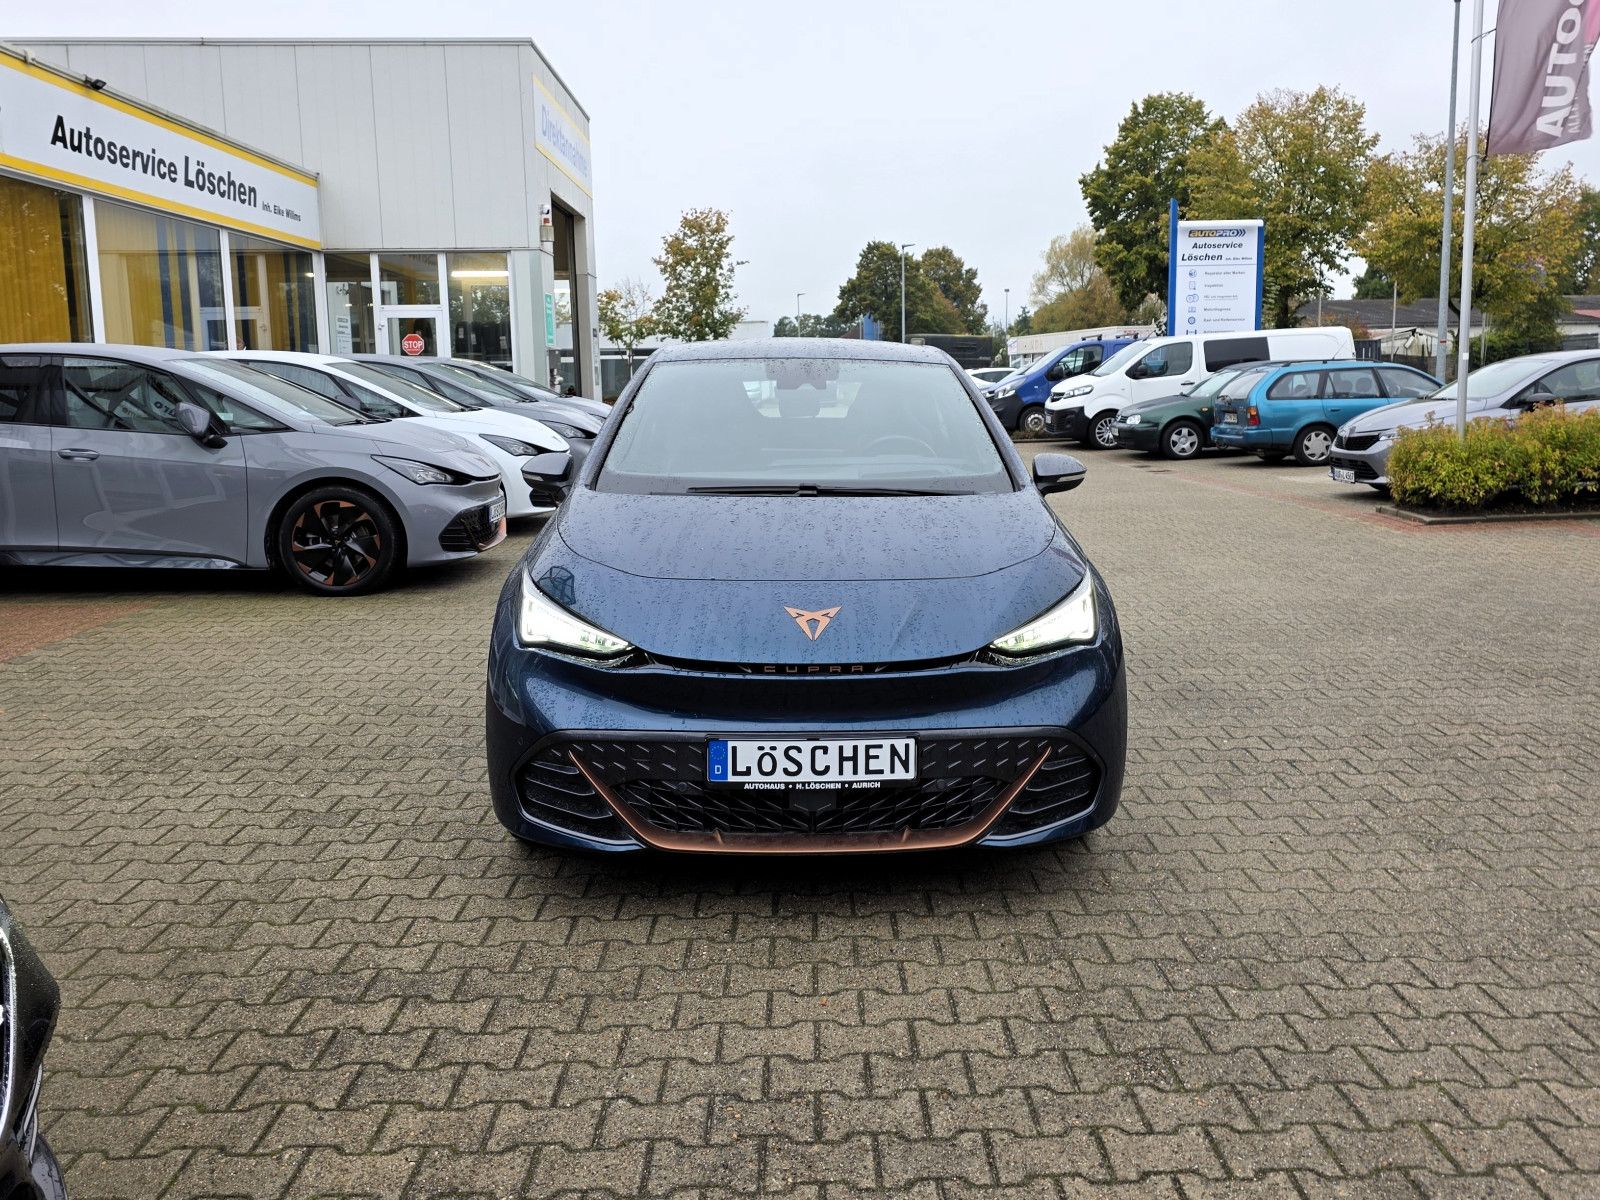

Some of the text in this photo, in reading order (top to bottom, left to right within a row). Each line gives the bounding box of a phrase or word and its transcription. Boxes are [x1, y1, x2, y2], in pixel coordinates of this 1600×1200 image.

[1536, 0, 1586, 138] AUTO
[50, 114, 178, 183] Autoservice
[184, 155, 258, 208] Löschen
[1191, 241, 1244, 250] Autoservice
[1181, 253, 1223, 262] Löschen
[404, 340, 423, 349] STOP
[764, 665, 864, 673] CUPRA
[714, 764, 722, 775] D
